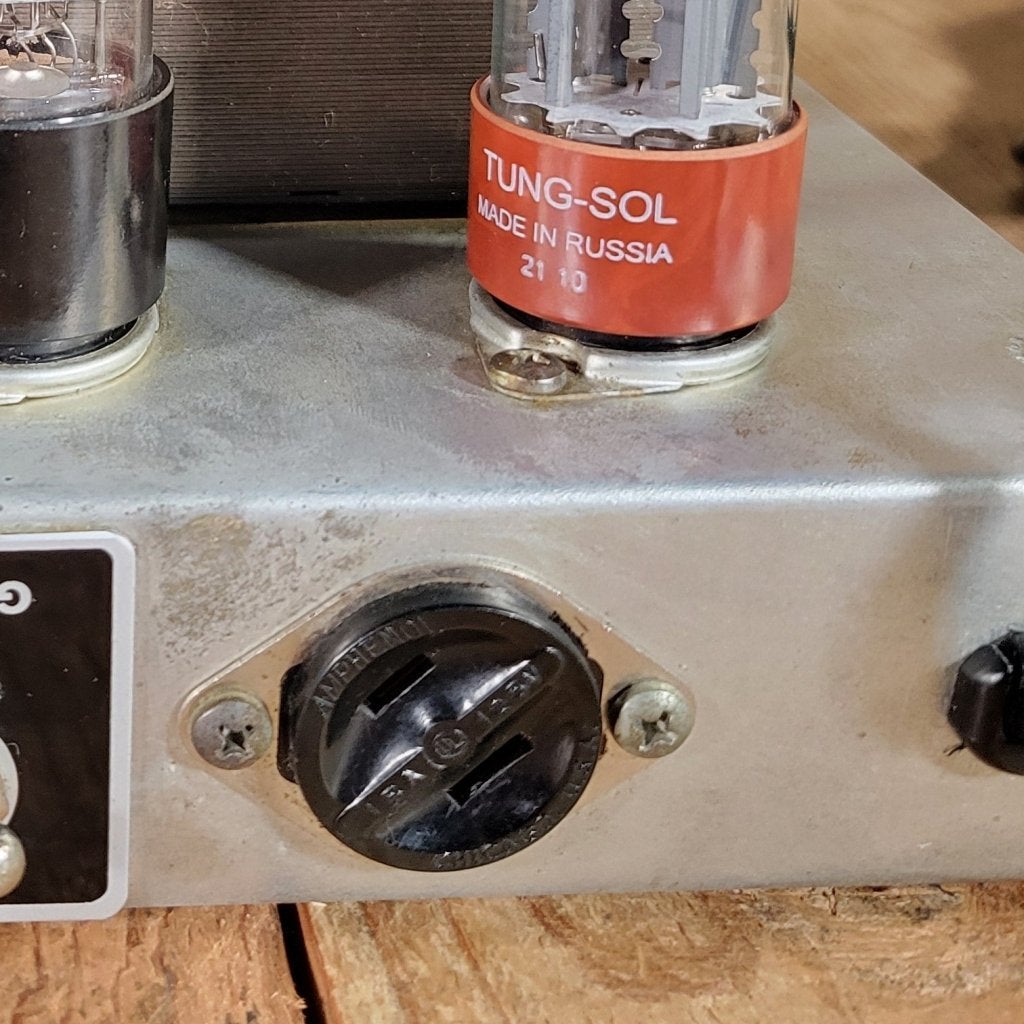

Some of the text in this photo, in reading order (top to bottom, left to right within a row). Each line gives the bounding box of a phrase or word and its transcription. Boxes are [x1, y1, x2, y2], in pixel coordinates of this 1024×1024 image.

[483, 147, 678, 225] TUNG-SOL
[477, 193, 674, 265] MADE IN RUSSIA
[520, 253, 588, 294] 21 10
